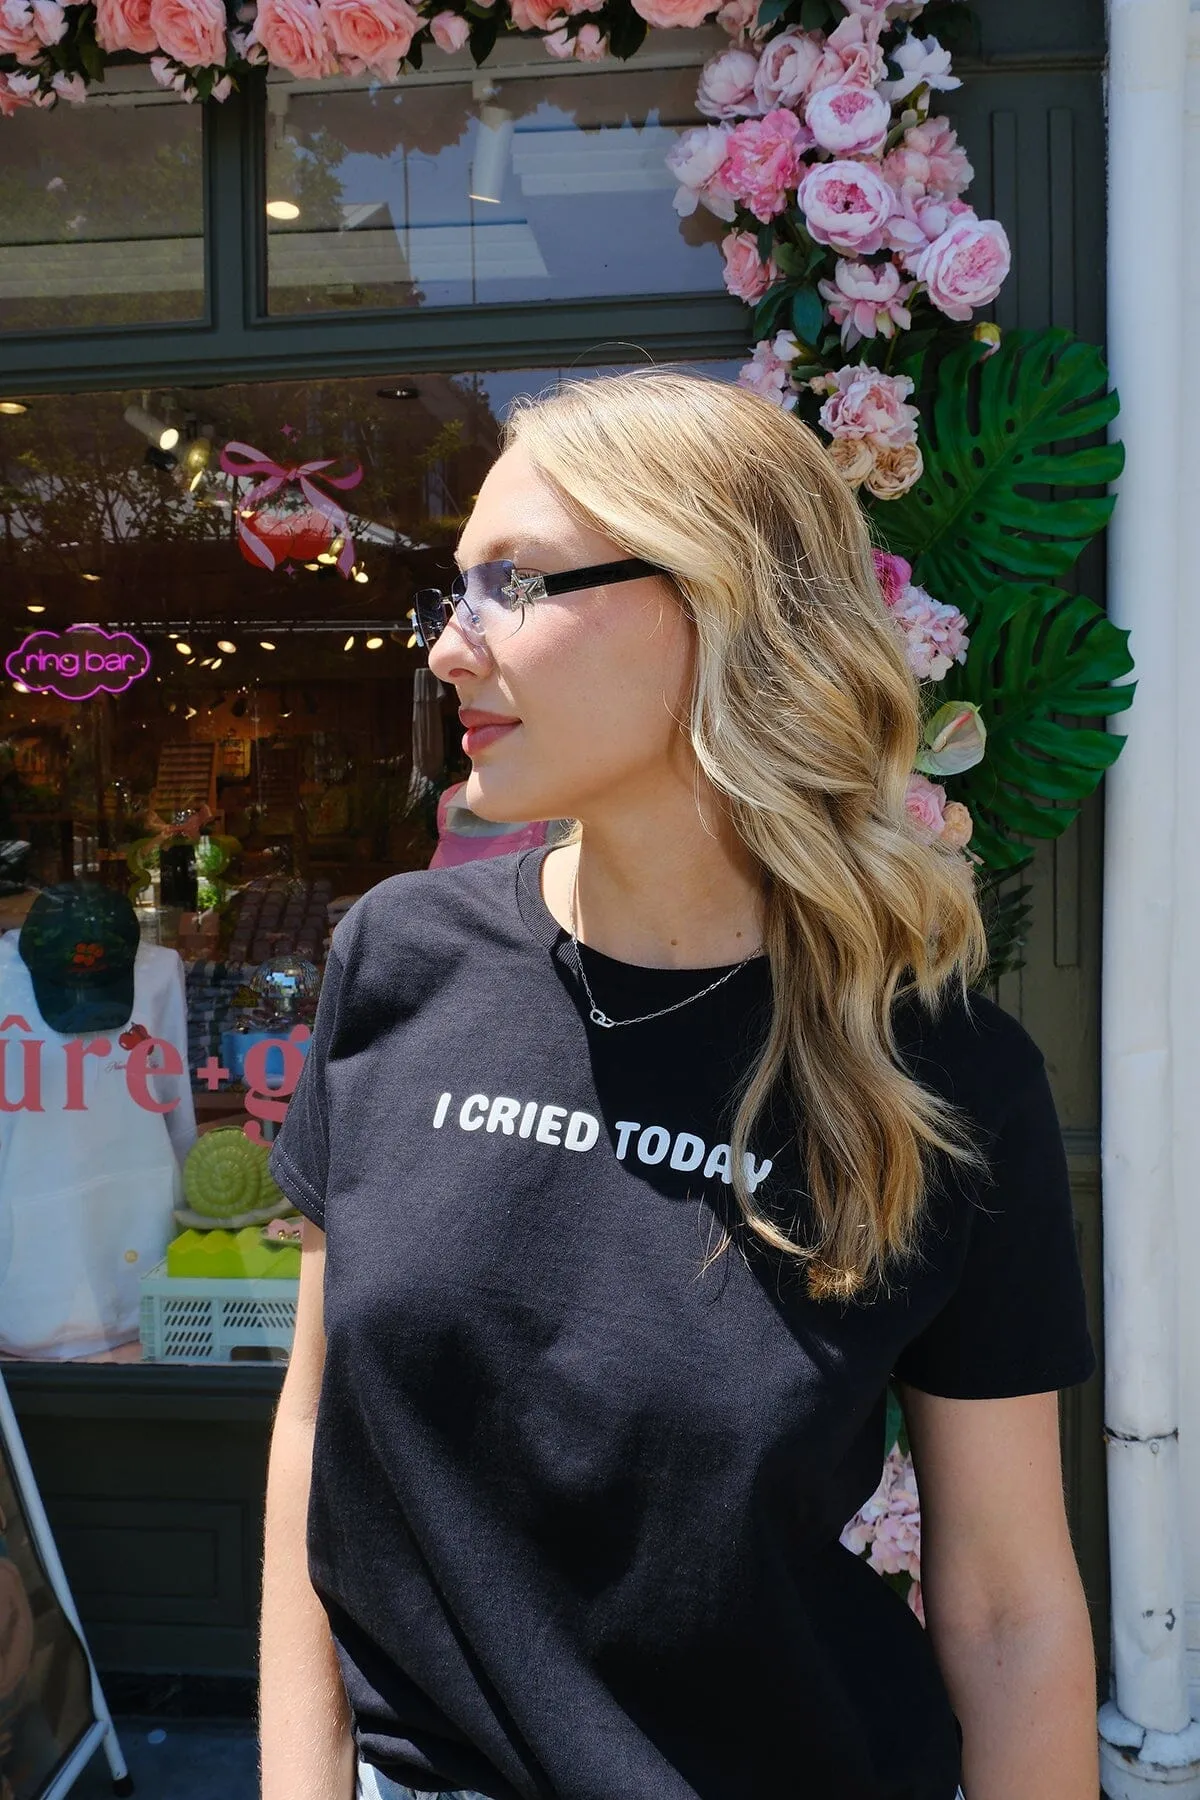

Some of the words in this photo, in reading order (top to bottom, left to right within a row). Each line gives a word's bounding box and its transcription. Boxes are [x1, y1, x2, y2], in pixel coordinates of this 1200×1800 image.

[26, 649, 79, 677] ring
[85, 650, 135, 672] bar
[433, 1092, 451, 1129] I
[459, 1093, 600, 1152] CRIED
[615, 1120, 773, 1193] TODAY
